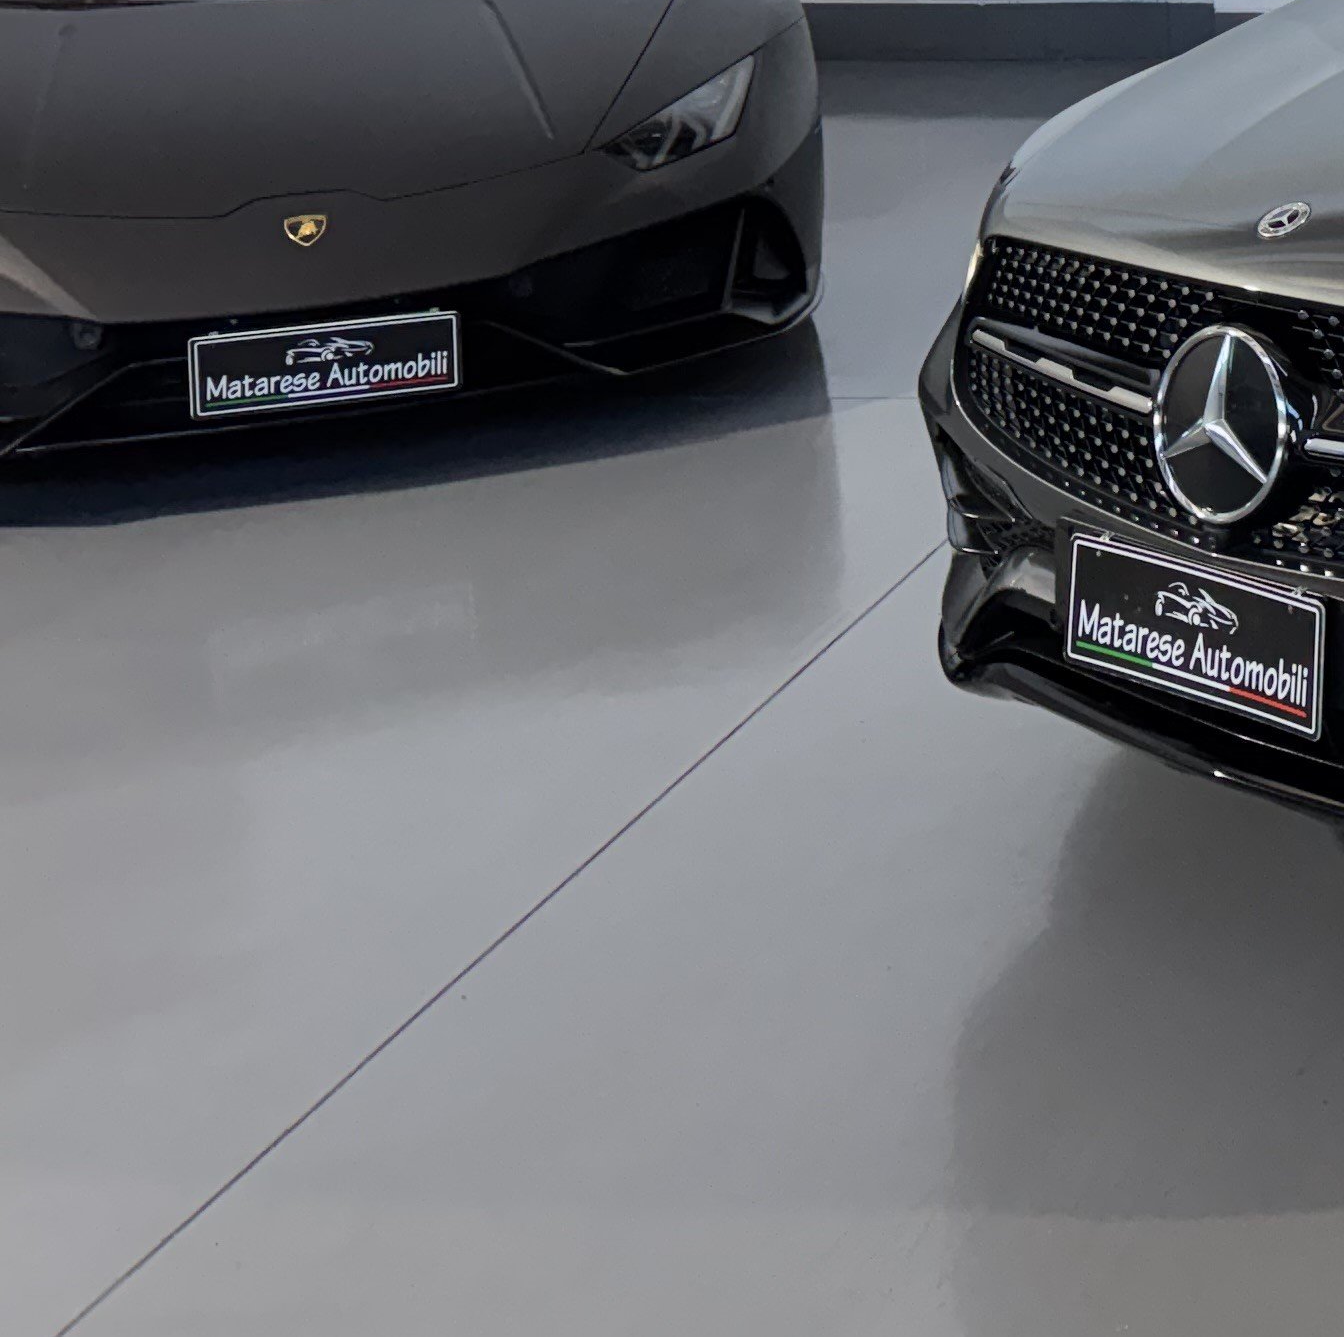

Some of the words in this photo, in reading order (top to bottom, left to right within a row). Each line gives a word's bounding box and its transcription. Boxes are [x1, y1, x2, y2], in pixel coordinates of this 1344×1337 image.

[206, 372, 320, 401] Matarese
[327, 351, 448, 387] Automobili
[1078, 599, 1186, 667] Matarese
[1190, 633, 1309, 707] Automobili
